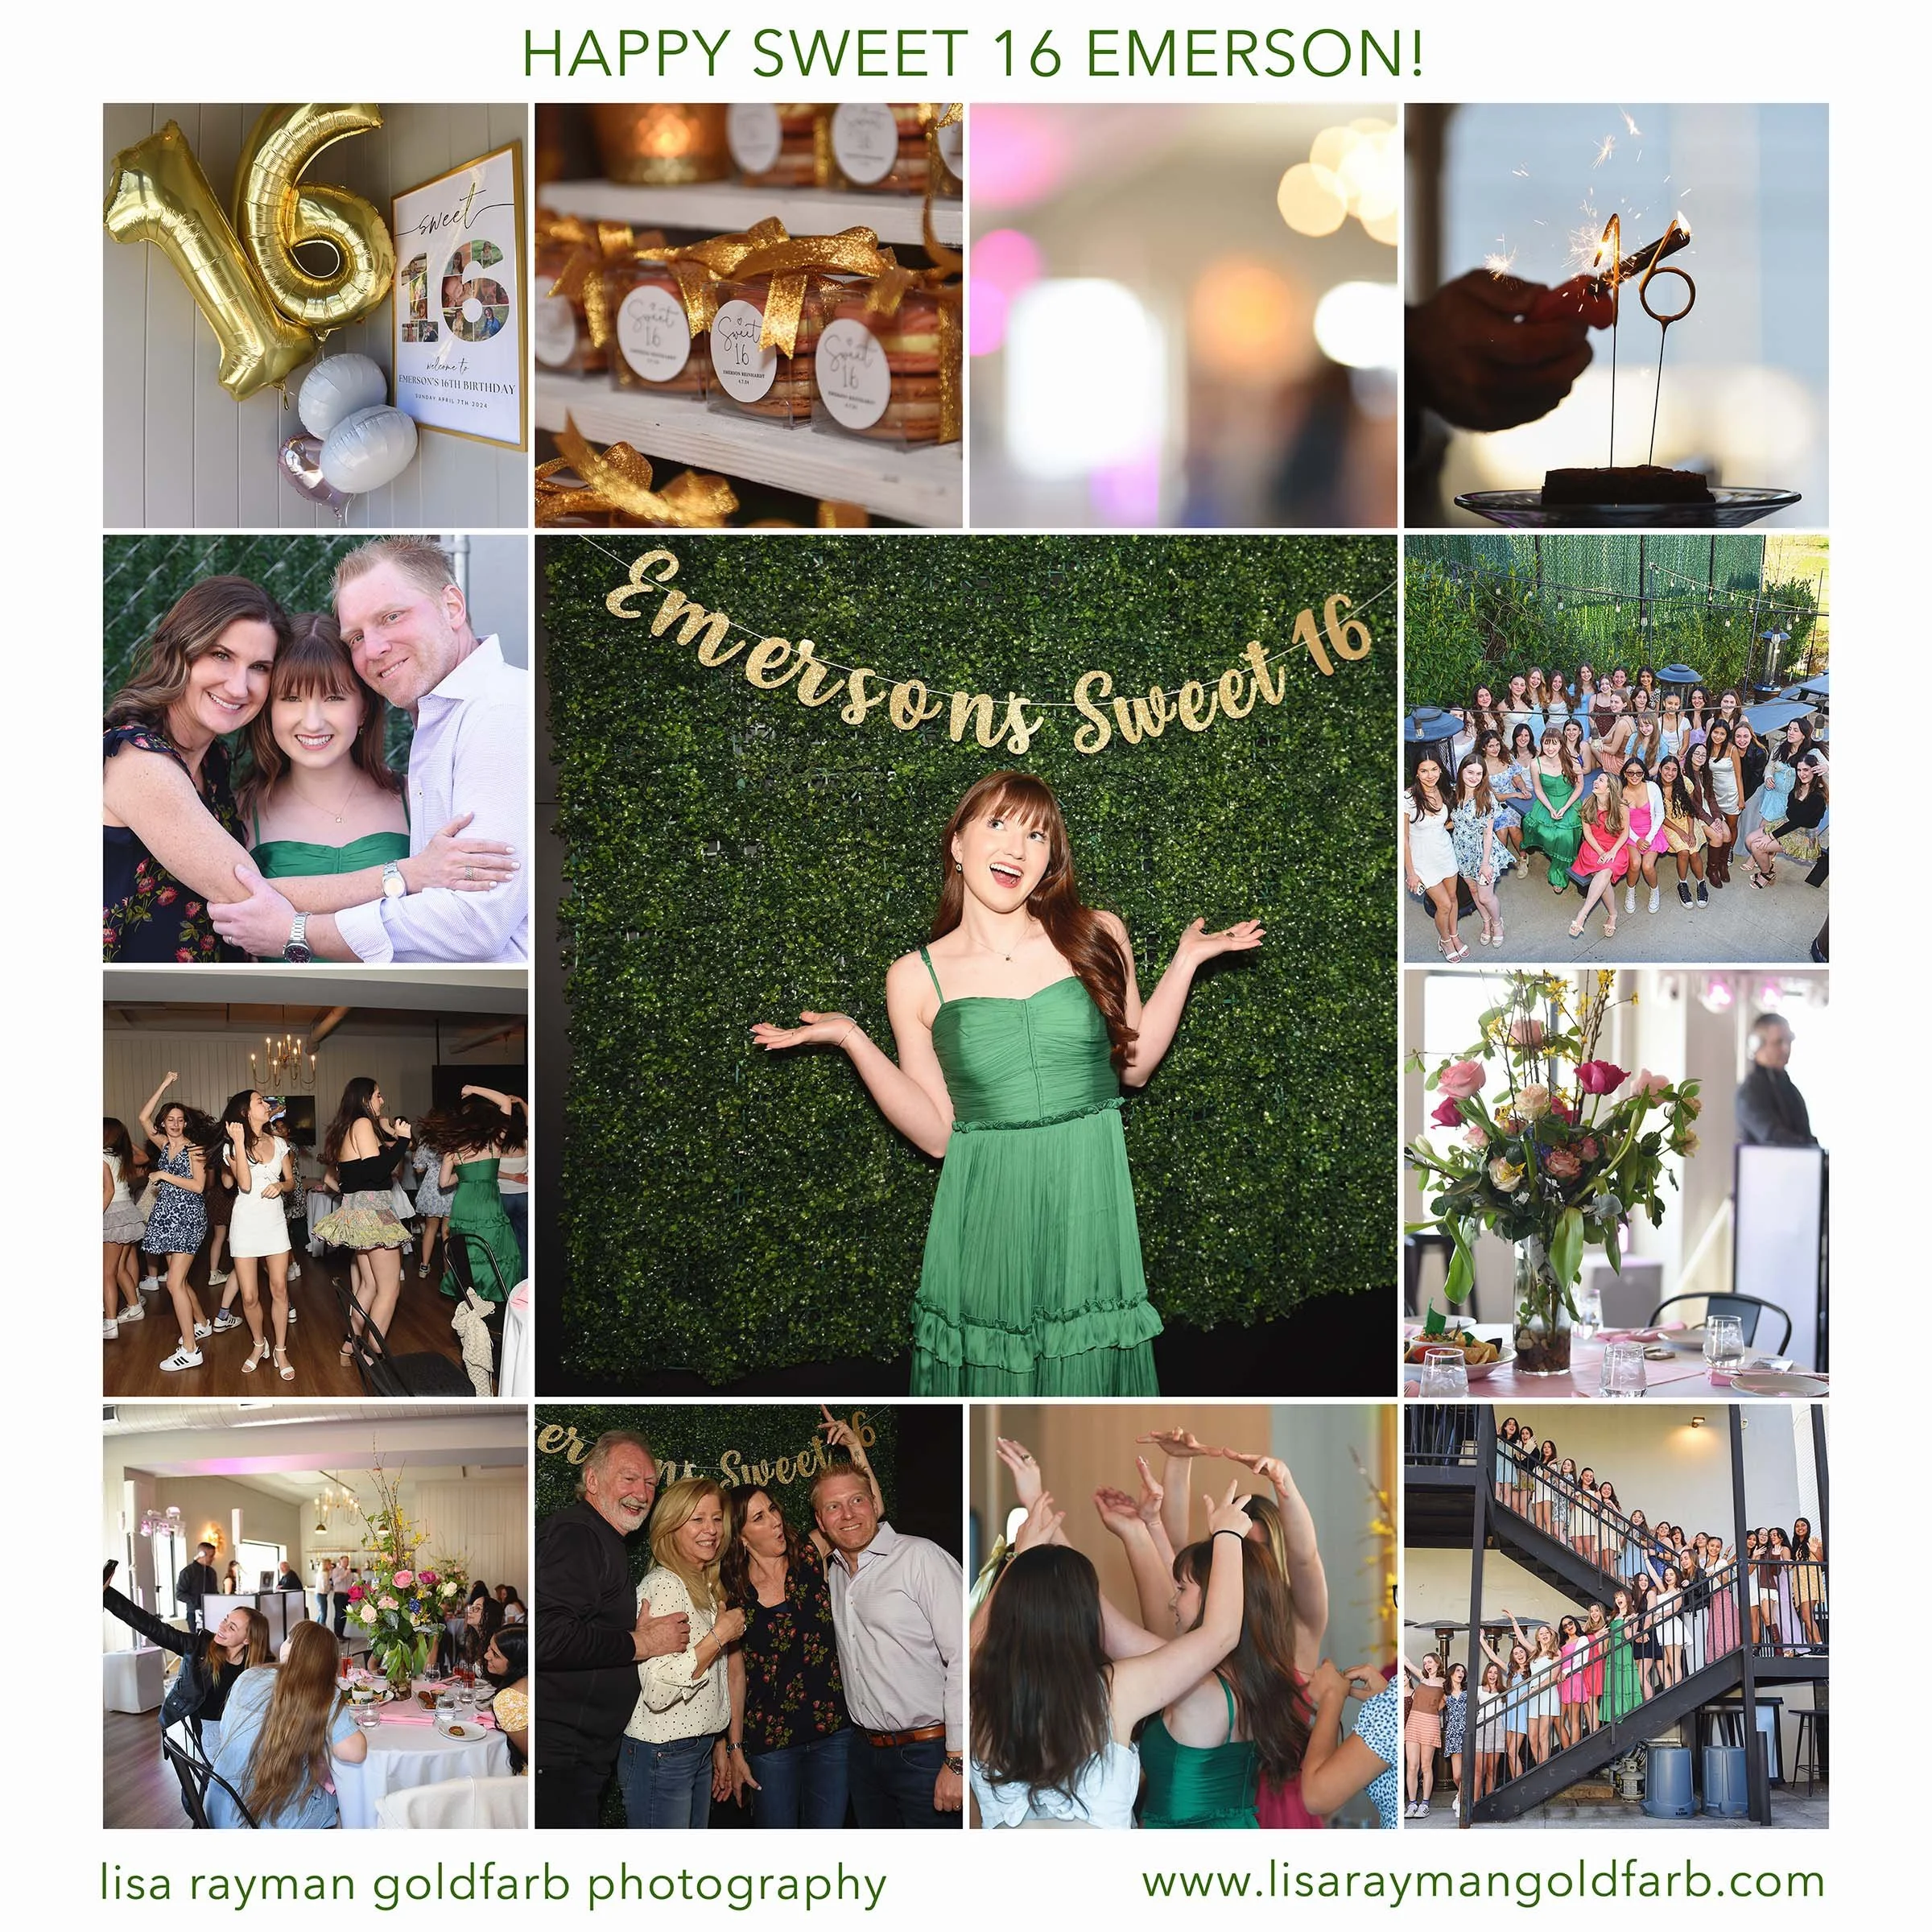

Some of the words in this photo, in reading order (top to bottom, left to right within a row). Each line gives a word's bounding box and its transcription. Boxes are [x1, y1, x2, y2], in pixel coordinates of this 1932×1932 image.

[394, 182, 514, 235] sweet
[401, 239, 510, 343] 16
[646, 326, 661, 348] 16
[735, 343, 749, 365] 16
[426, 357, 456, 372] welcome
[457, 357, 470, 375] to
[843, 365, 860, 390] 16
[398, 374, 440, 387] EMERSON'S
[440, 378, 461, 390] 16TH
[463, 380, 516, 395] BIRTHDAY
[415, 393, 436, 401] SUNDAY
[438, 396, 455, 404] APRIL
[472, 401, 488, 409] 2024
[605, 549, 1045, 755] Emersons
[1073, 640, 1286, 754] Sweet
[1292, 594, 1371, 676] 16
[720, 1435, 832, 1489] Sweet
